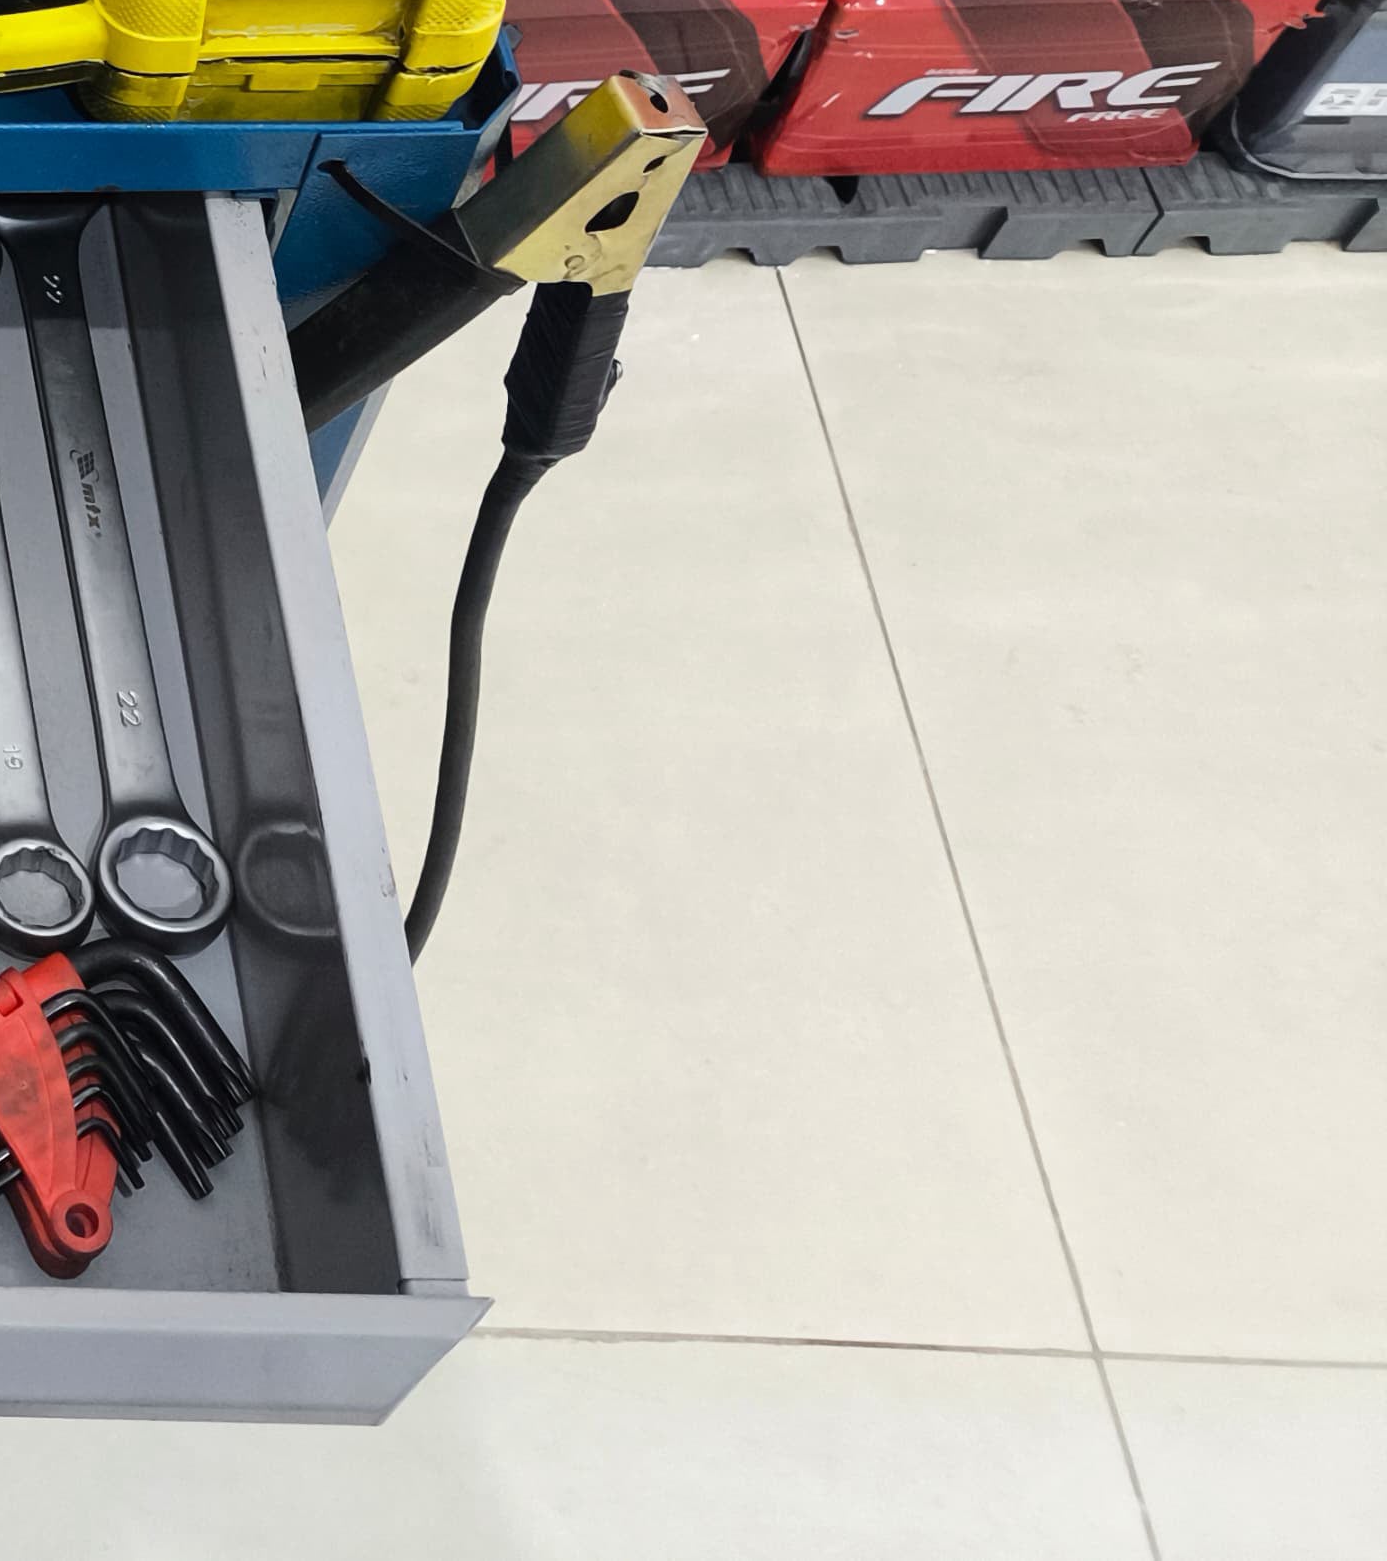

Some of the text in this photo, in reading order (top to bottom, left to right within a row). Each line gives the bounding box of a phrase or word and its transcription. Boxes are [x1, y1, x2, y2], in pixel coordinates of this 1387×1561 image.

[868, 62, 1222, 116] FIRE
[1067, 108, 1170, 123] FREE
[116, 690, 142, 728] 22
